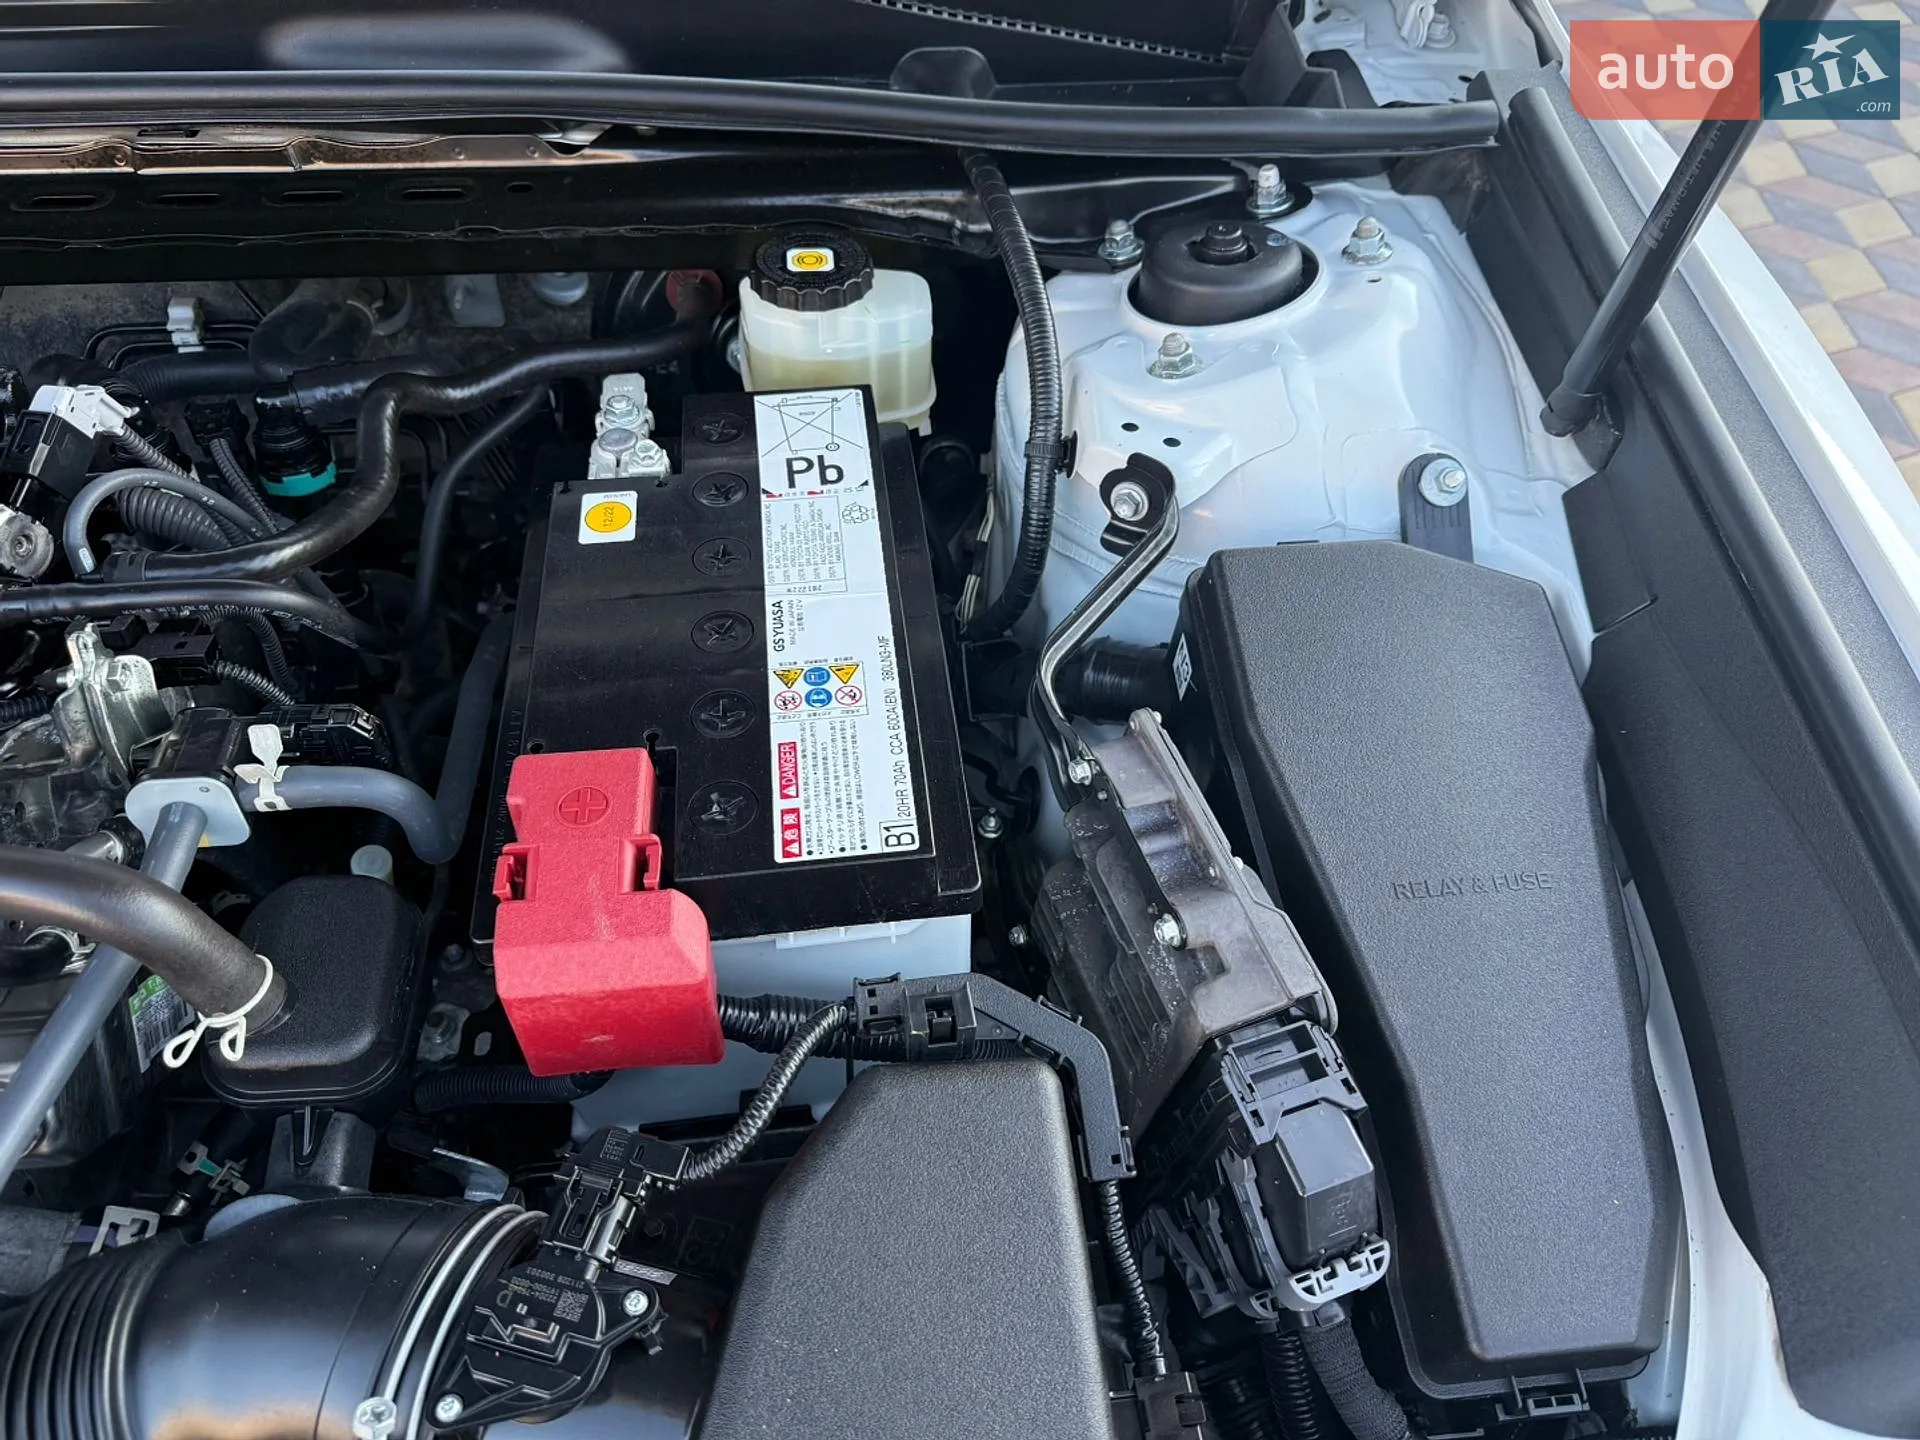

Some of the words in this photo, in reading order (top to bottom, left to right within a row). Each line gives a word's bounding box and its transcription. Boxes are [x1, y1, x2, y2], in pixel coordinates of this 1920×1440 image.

[786, 455, 844, 489] Pb
[772, 600, 784, 638] YUASA
[773, 638, 785, 652] GS
[889, 732, 904, 755] CCA
[780, 743, 797, 785] DANGER
[893, 760, 907, 786] 70Ah
[895, 790, 911, 818] 20HR
[883, 824, 915, 847] B1
[1392, 877, 1464, 900] RELAY
[1472, 876, 1489, 894] &
[1491, 871, 1553, 893] FUSE
